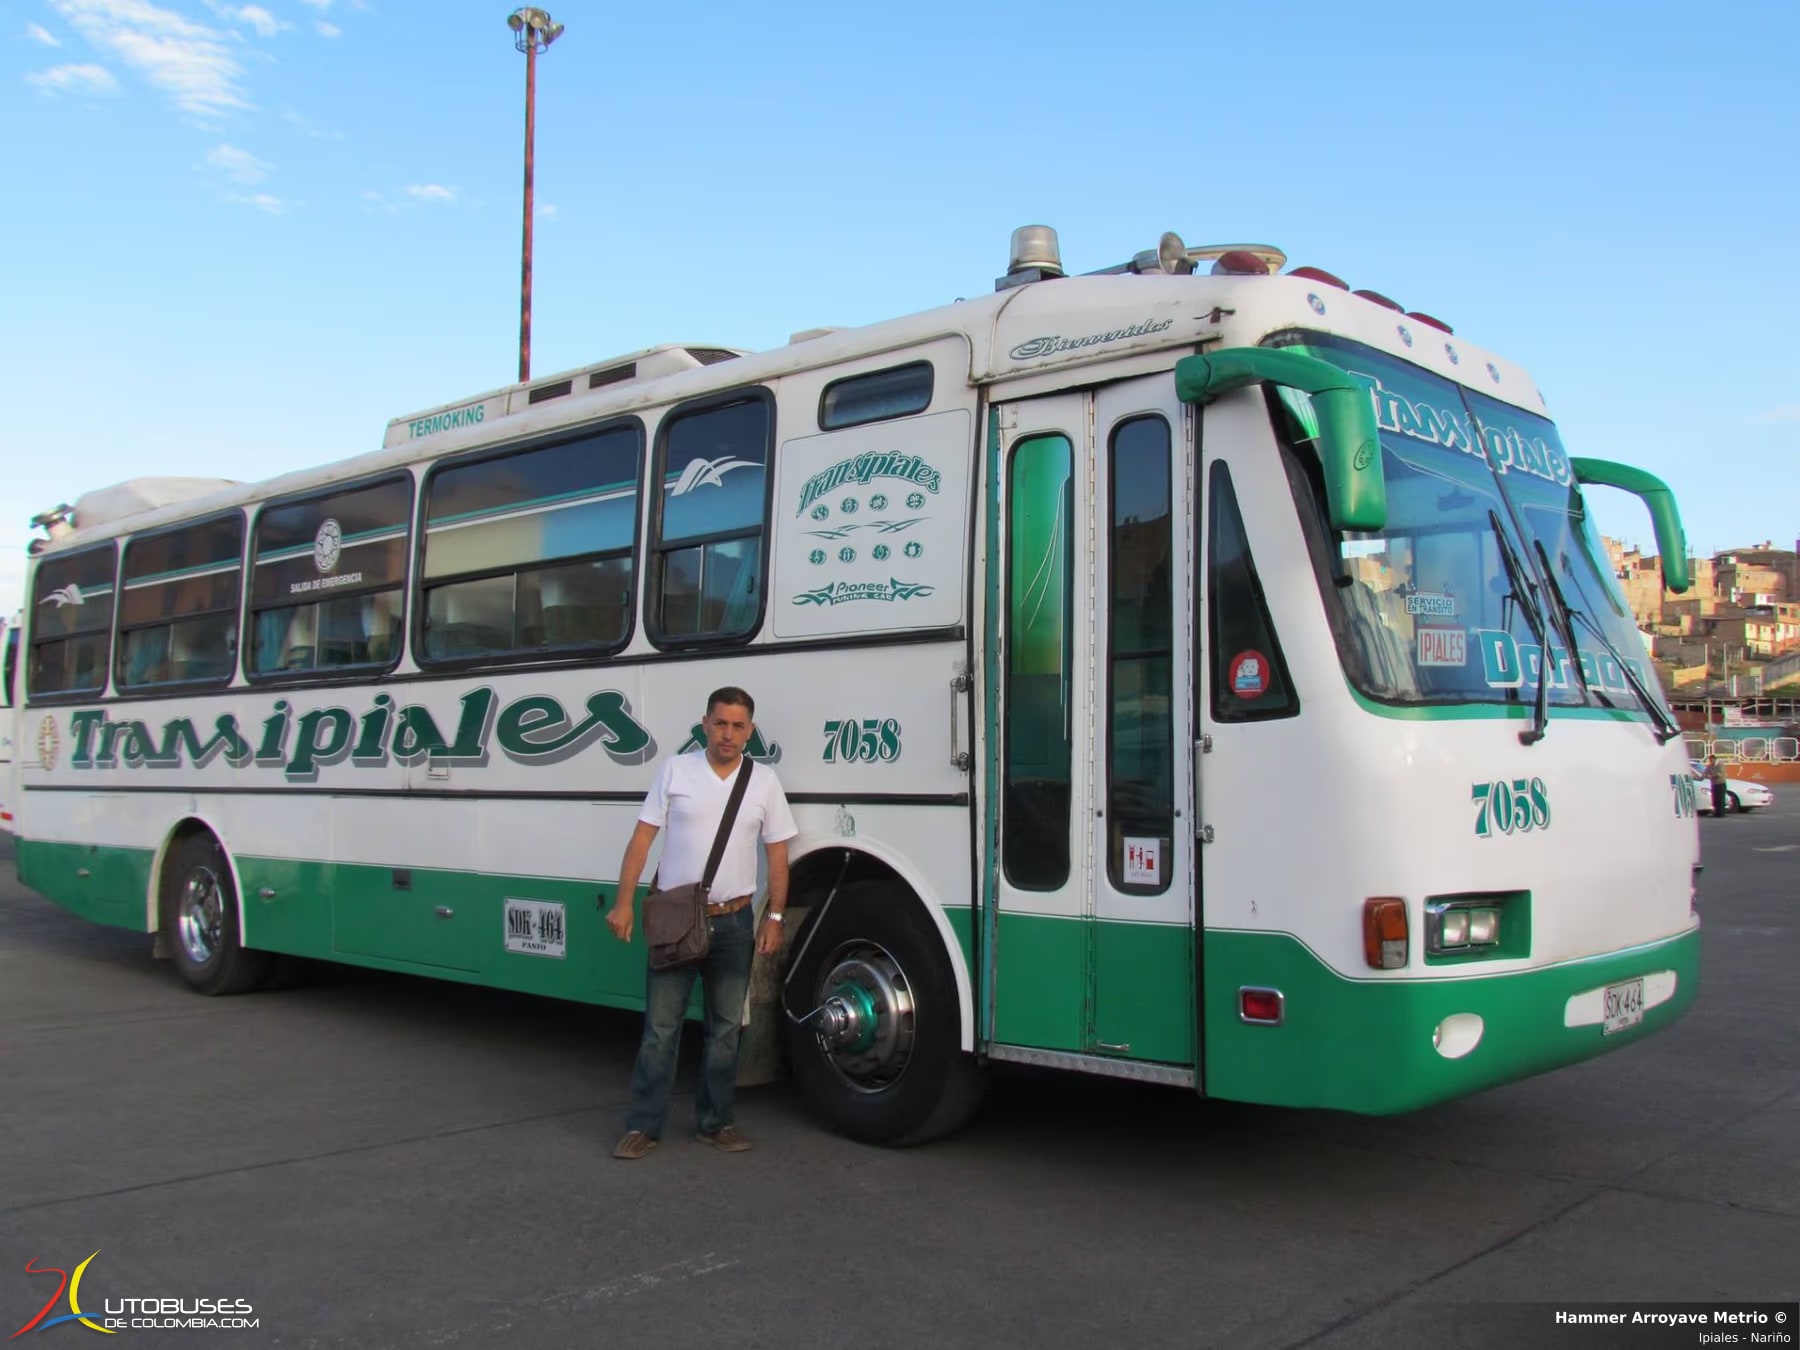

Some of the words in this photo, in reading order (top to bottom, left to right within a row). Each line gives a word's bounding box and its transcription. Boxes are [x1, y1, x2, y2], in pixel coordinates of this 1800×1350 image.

[408, 404, 485, 439] TERMOKING
[796, 450, 942, 519] Transipiales
[290, 581, 311, 593] SALIDA
[312, 579, 321, 590] DE
[321, 572, 362, 588] EMERGENCIA
[836, 582, 889, 595] Pioneer
[1407, 597, 1453, 607] SERVICIO
[1407, 604, 1417, 612] EN
[1420, 605, 1453, 614] TRANSITO
[1420, 632, 1463, 663] IPIALES
[70, 685, 658, 783] Transipiales
[821, 718, 901, 763] 7058
[1471, 777, 1550, 838] 7058
[521, 941, 546, 951] PASTO
